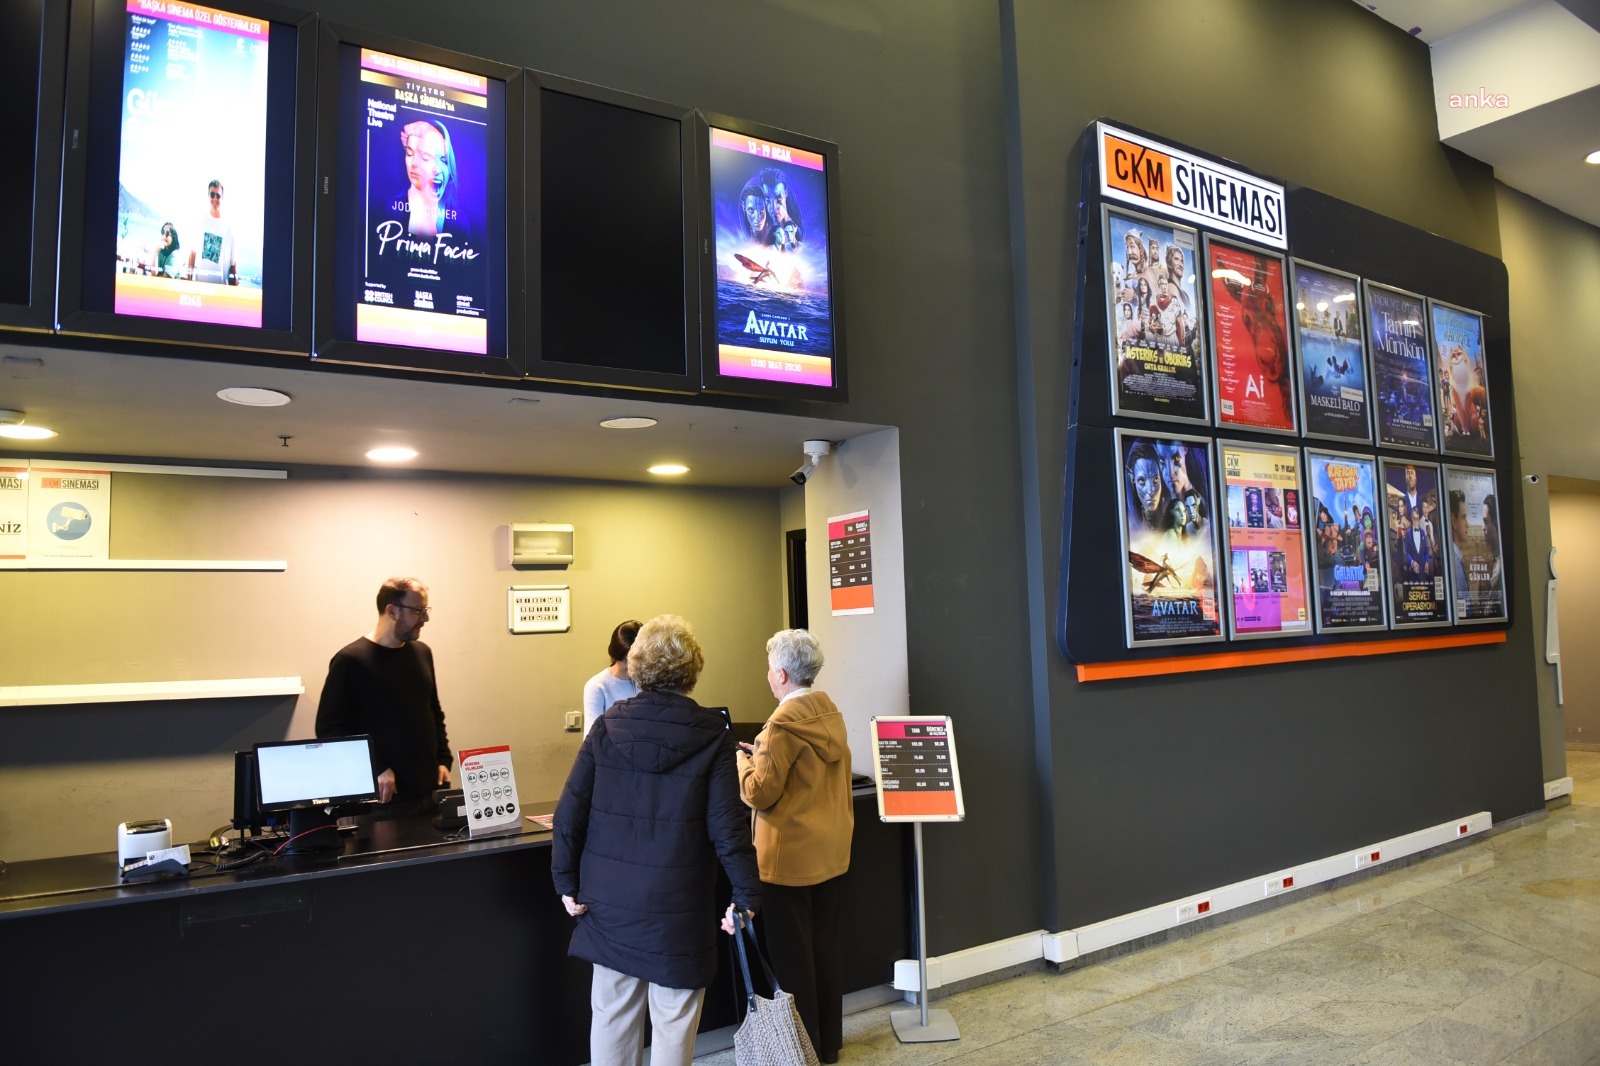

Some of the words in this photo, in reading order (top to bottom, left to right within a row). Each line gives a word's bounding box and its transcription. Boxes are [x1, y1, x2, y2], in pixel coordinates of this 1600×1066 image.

[167, 3, 194, 18] SİNEMA
[195, 8, 212, 23] ÖZEL
[213, 12, 260, 34] GÖSTERİMLERİ
[395, 89, 418, 104] BAŞKA
[406, 82, 445, 96] TİYATRO
[368, 98, 397, 112] National
[368, 108, 394, 121] Theatre
[368, 116, 382, 128] Live
[748, 141, 756, 153] 13
[762, 144, 770, 156] 19
[772, 147, 792, 162] OCAK
[1115, 148, 1164, 196] CKM
[1176, 163, 1282, 236] SİNEMASI
[376, 220, 432, 258] Prima
[433, 232, 480, 264] Facie
[744, 310, 808, 340] AVATAR
[760, 336, 778, 344] SUYUN
[1376, 330, 1424, 361] Mümkün
[1126, 346, 1158, 362] ASTERİKS
[1164, 350, 1192, 368] OBURİKS
[1246, 374, 1264, 399] Ai
[1311, 394, 1341, 409] MASKELİ
[1342, 400, 1360, 412] BALO
[62, 478, 98, 489] SİNEMASI
[1469, 572, 1490, 580] GÜNLER
[1408, 591, 1430, 600] SERVET
[1152, 600, 1198, 616] AVATAR
[1402, 602, 1438, 611] OPERASYONU
